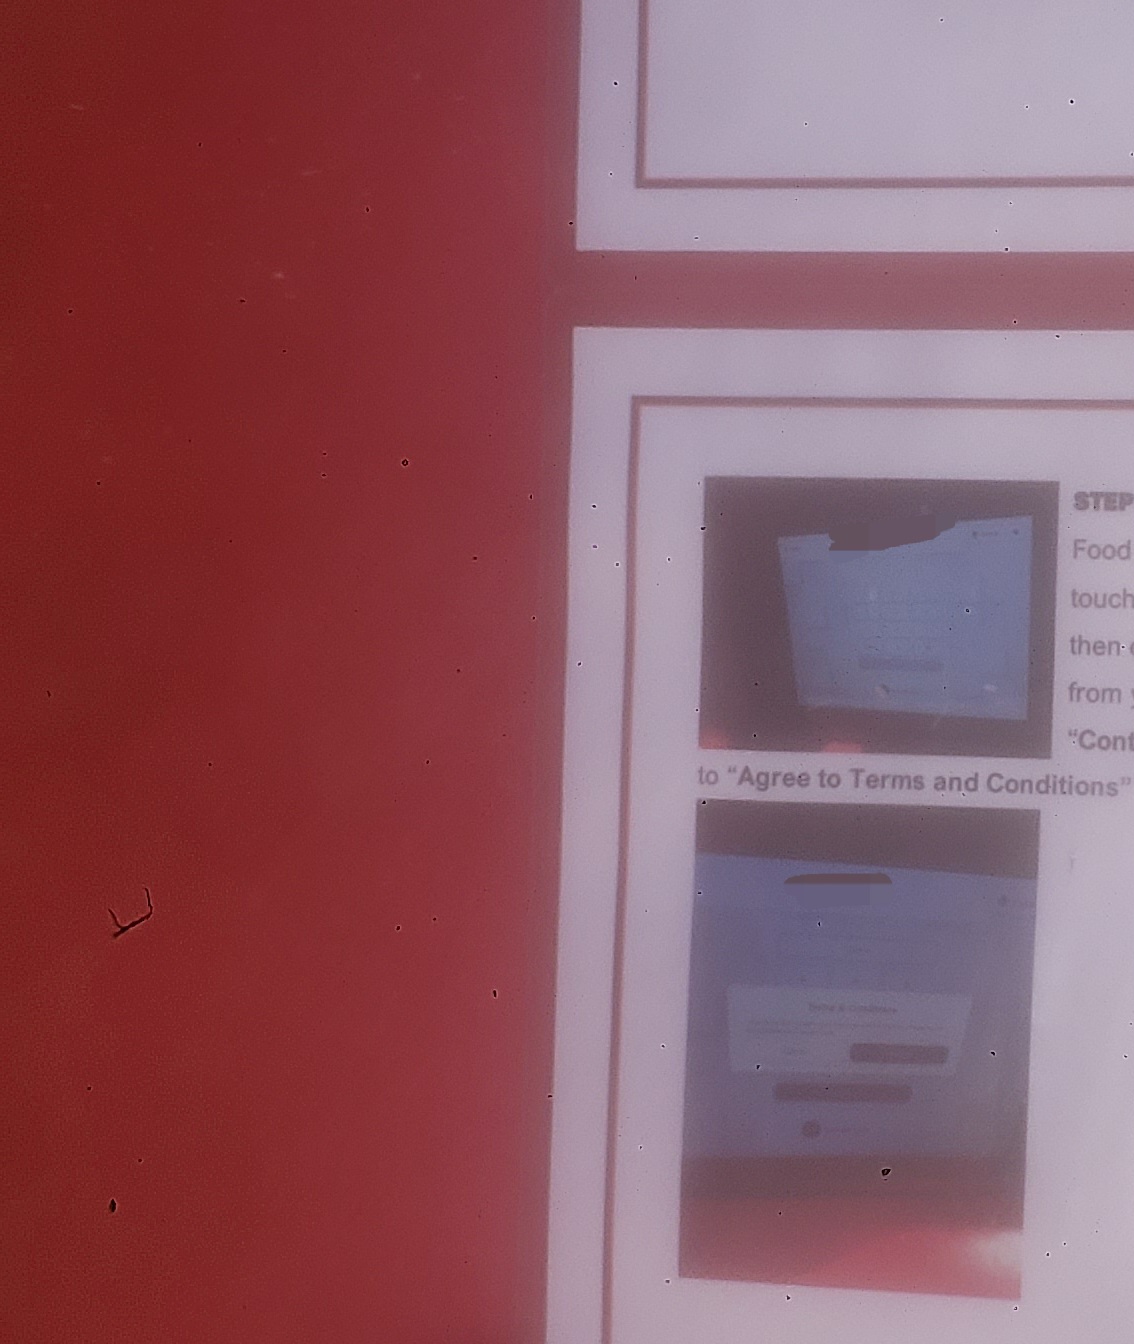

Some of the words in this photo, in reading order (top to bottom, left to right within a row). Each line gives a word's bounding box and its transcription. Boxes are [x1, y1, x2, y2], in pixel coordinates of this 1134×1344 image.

[1073, 490, 1134, 512] STEP
[1070, 537, 1132, 561] Food
[1068, 634, 1121, 657] then
[1066, 680, 1123, 704] from
[697, 766, 720, 787] to
[817, 769, 842, 790] to
[849, 767, 926, 791] Terms
[932, 772, 980, 793] and
